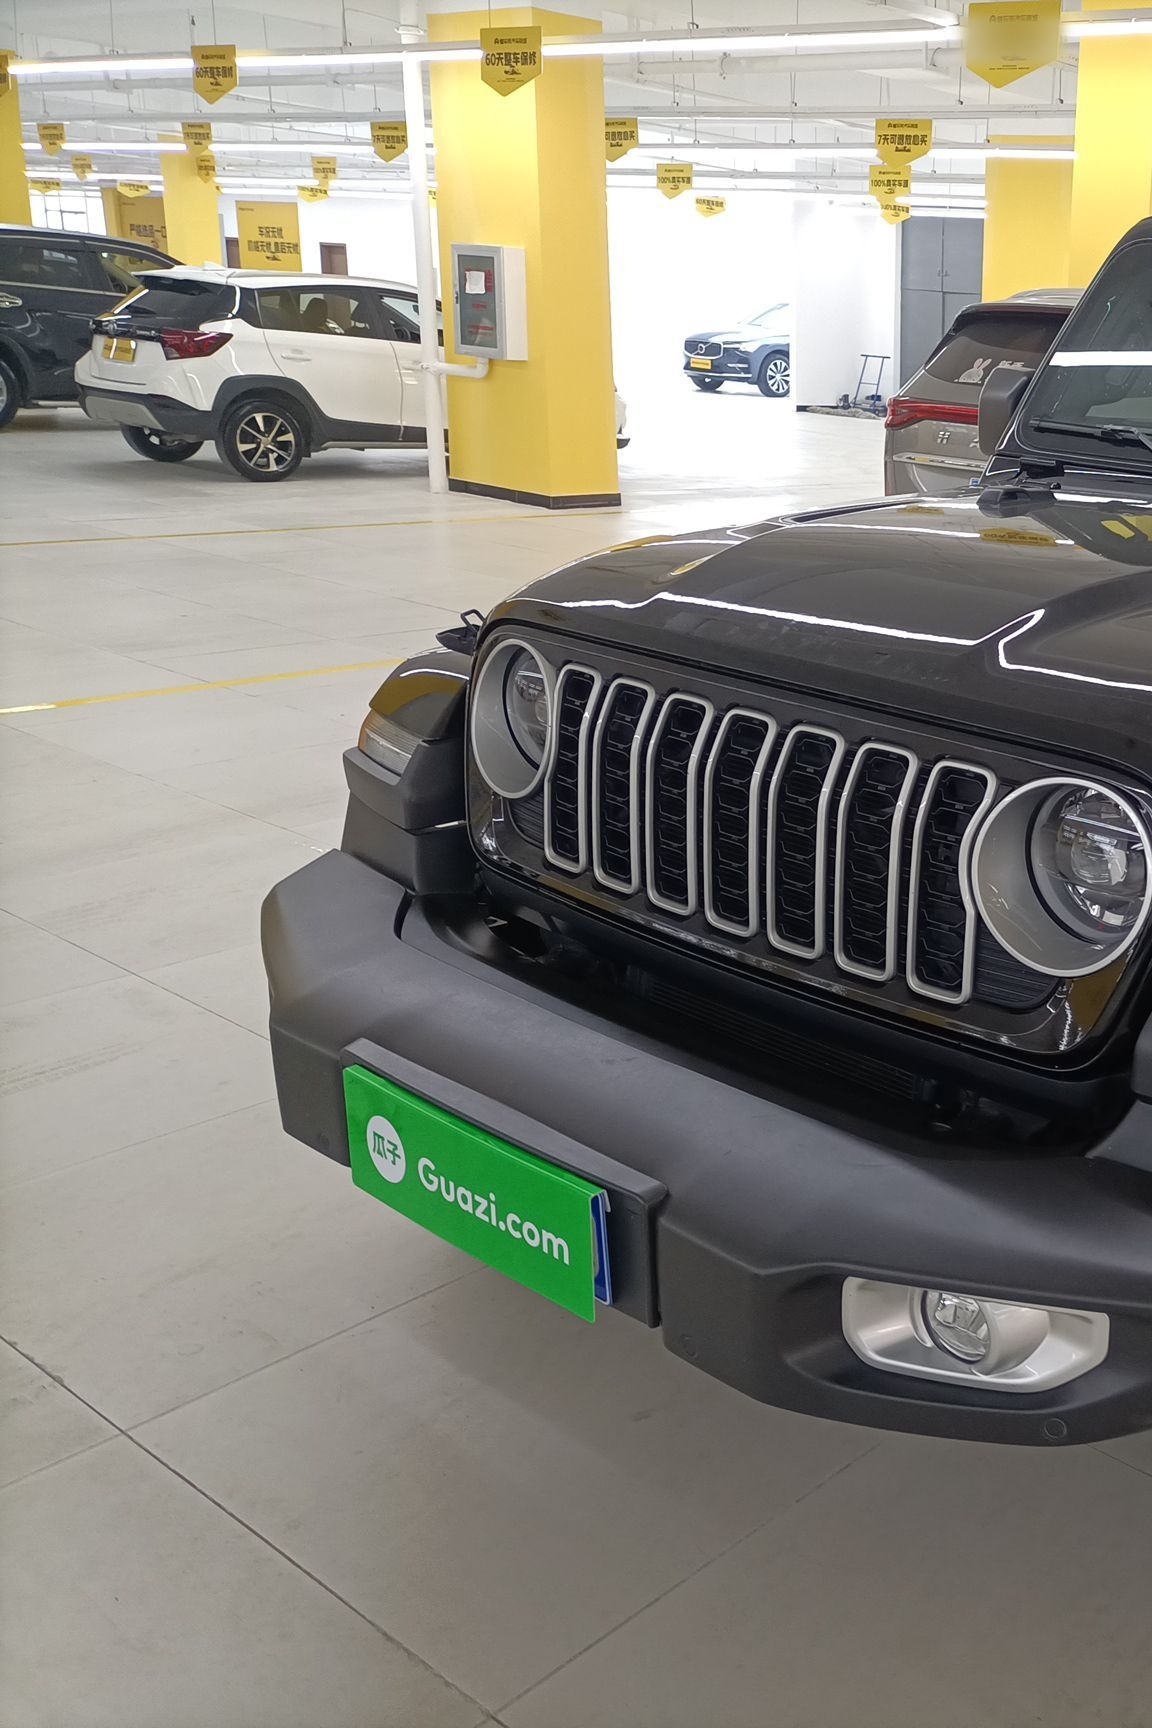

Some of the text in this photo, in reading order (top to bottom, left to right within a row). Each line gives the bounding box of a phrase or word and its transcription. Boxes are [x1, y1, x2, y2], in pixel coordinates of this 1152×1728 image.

[485, 51, 537, 66] 60天整车保修
[372, 1130, 402, 1166] 瓜子
[417, 1157, 570, 1266] Guazi.com
